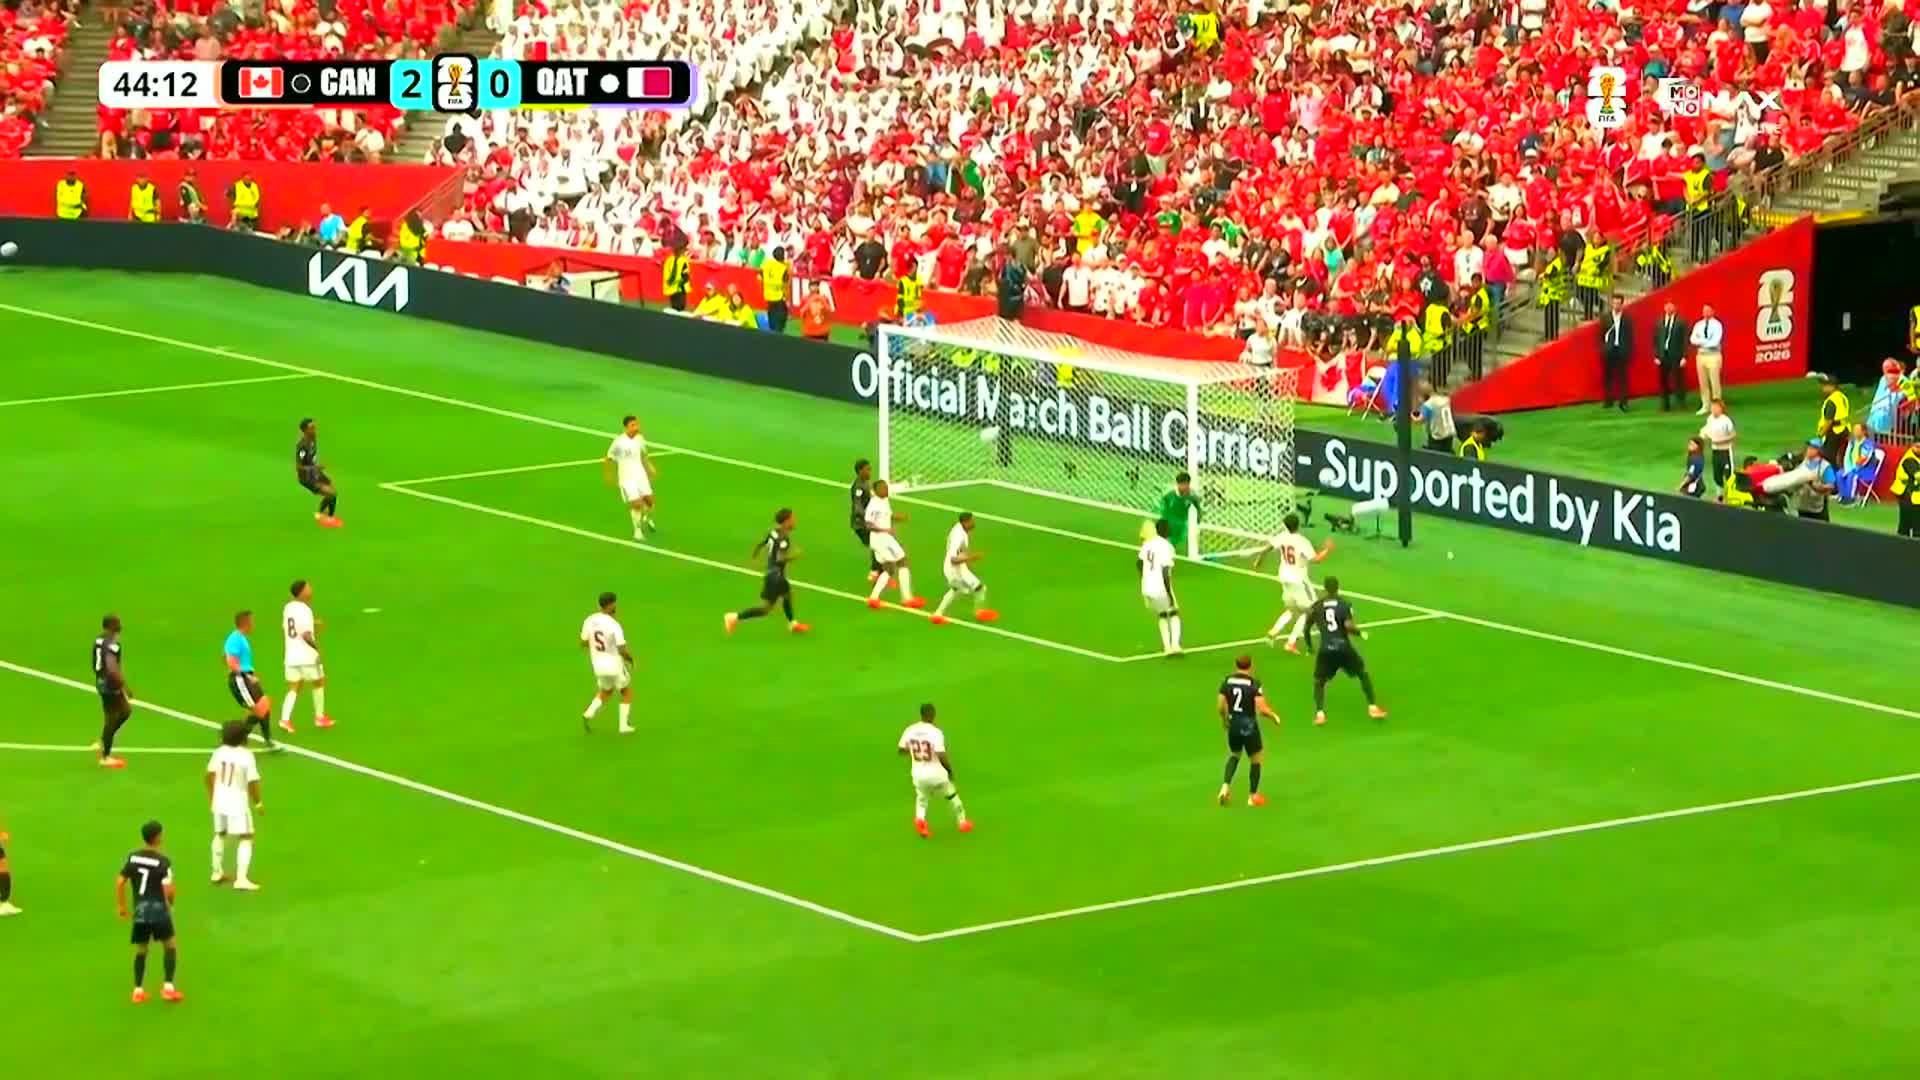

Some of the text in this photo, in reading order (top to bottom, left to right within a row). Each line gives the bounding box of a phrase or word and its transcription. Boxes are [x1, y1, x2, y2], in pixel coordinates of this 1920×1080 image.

[1766, 326, 1783, 335] FIFA
[1089, 396, 1150, 450] Ball
[1549, 479, 1599, 546] by
[1614, 490, 1680, 552] Kia
[1281, 544, 1295, 565] 16
[287, 617, 297, 638] 8
[1325, 609, 1337, 631] 9
[594, 630, 605, 652] 5
[1232, 687, 1244, 712] 2
[910, 738, 932, 761] 23
[221, 760, 235, 787] 11
[137, 868, 149, 895] 7
